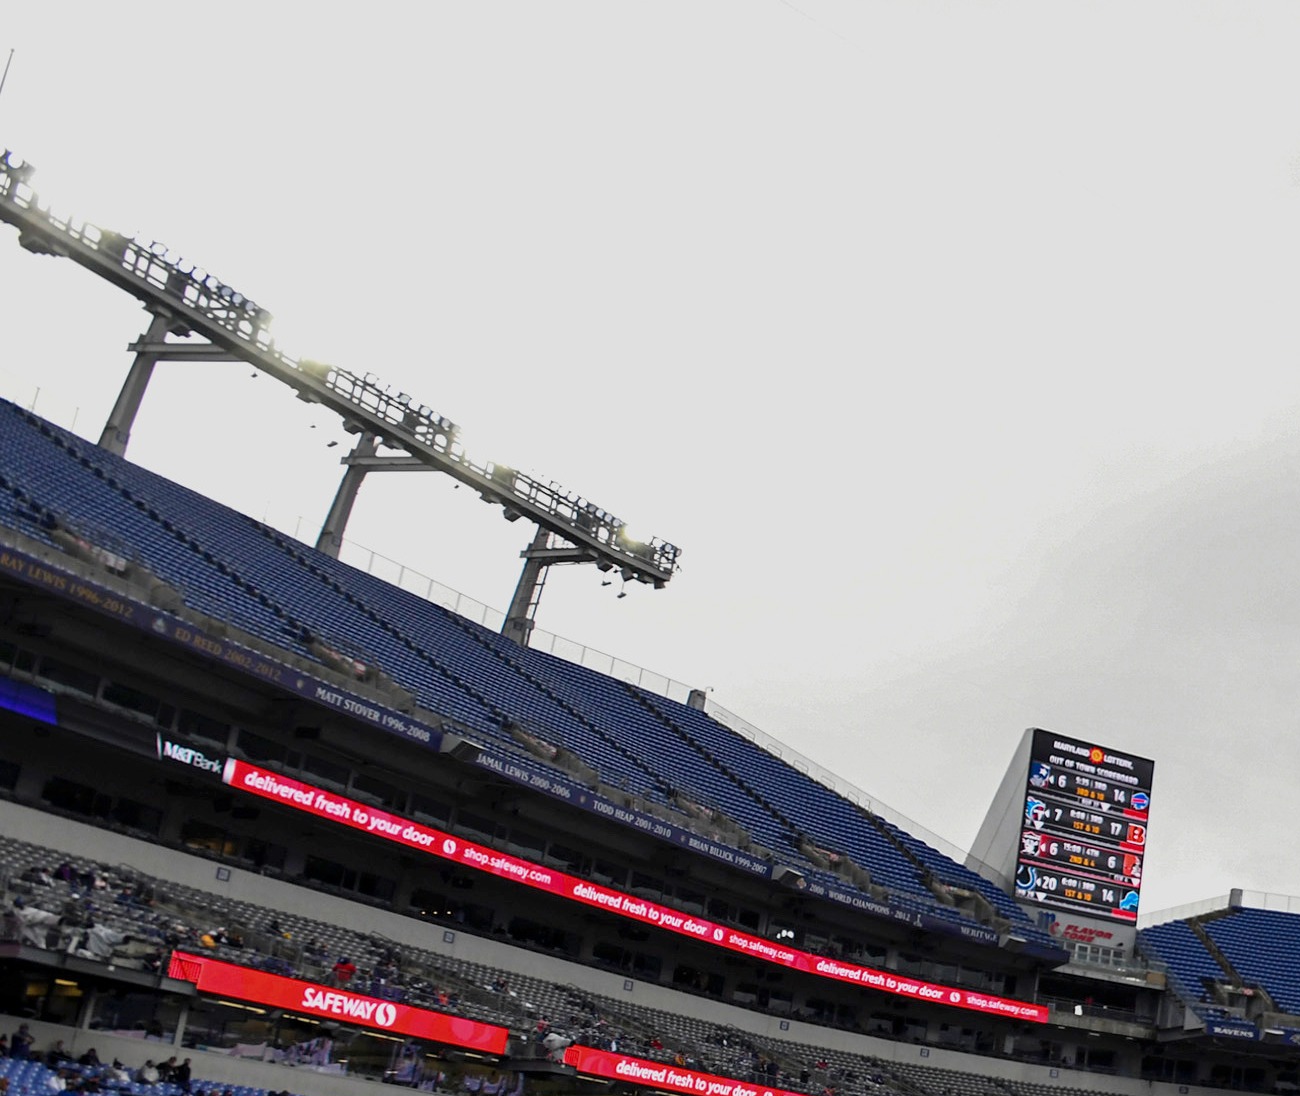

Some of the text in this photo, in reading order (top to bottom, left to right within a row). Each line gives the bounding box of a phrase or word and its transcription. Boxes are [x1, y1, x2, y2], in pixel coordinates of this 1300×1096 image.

[315, 686, 431, 743] MATT STOVER 1996-2008
[476, 752, 503, 771] JAMAL
[505, 762, 530, 782] LEWIS
[1058, 775, 1126, 803] 6 14
[244, 771, 552, 885] delivered fresh to your door shop.safeway.com
[592, 800, 672, 838] TODD HEAP 2001-2010
[1054, 808, 1122, 835] 7 17
[687, 838, 707, 853] BRIAN
[708, 844, 734, 863] BILLICK
[1049, 843, 1116, 868] 6 6
[1043, 876, 1114, 903] 20 14
[573, 883, 795, 963] delivered fresh to your door shop.safeway.com
[1065, 925, 1114, 940] FLAVOR
[302, 987, 378, 1019] SAFEWAY
[816, 960, 1039, 1018] delivered fresh to your door shop.safeway.com
[1213, 1026, 1254, 1039] RAVENS
[616, 1059, 665, 1084] delivered
[666, 1068, 694, 1089] fresh
[695, 1078, 707, 1093] to
